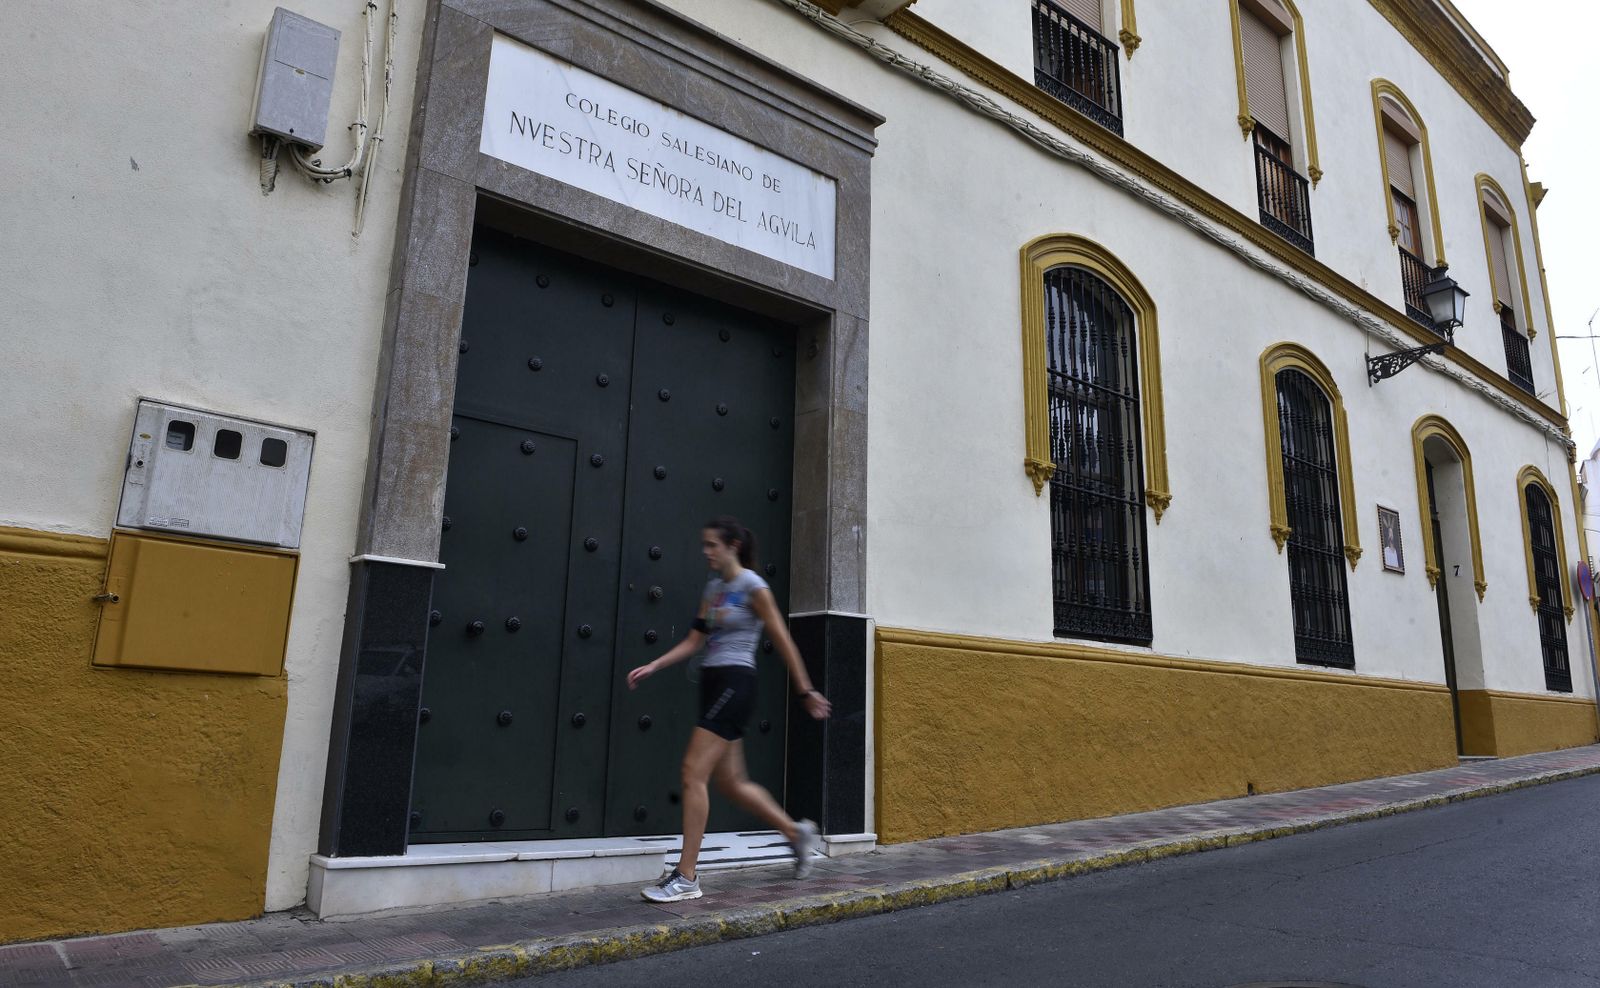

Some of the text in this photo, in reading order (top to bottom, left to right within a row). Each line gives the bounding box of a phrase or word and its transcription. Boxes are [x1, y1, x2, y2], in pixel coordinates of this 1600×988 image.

[509, 111, 816, 250] NVESTRA SEÑORA DEL AGVILA
[565, 92, 782, 194] COLEGIO SALESIANO DE
[1453, 565, 1460, 577] 7
